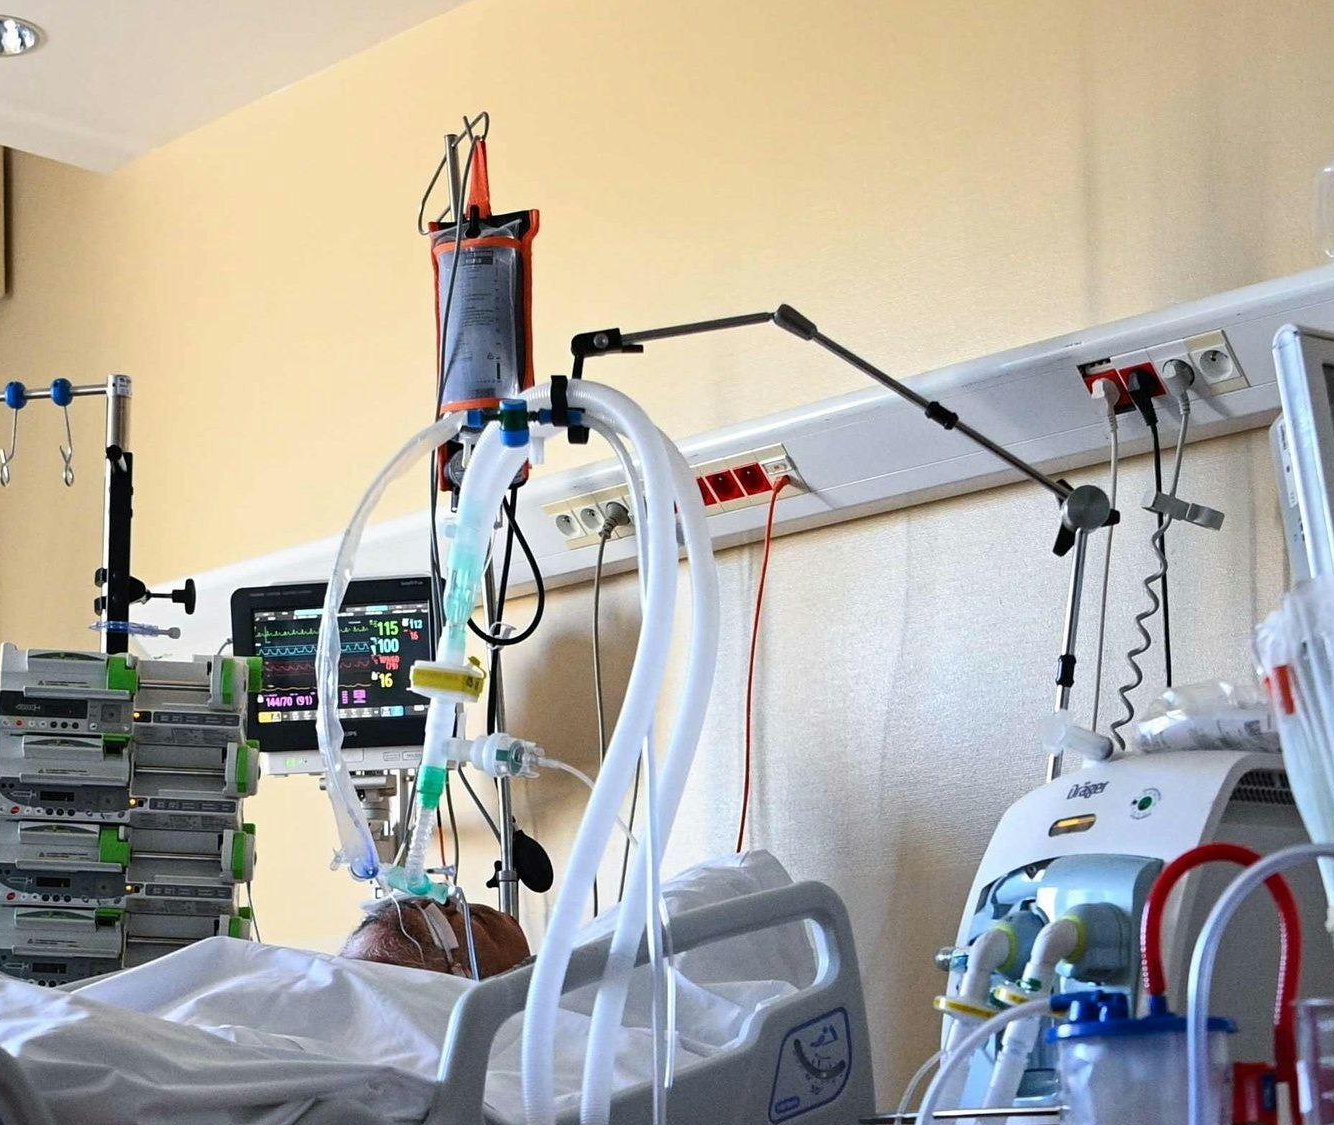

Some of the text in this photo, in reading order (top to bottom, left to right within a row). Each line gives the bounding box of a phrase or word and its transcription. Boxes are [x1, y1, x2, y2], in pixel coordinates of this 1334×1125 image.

[378, 620, 399, 636] 115
[378, 637, 400, 653] 100
[379, 672, 394, 688] 16
[266, 696, 293, 708] 144/70
[1066, 781, 1110, 800] Dräger
